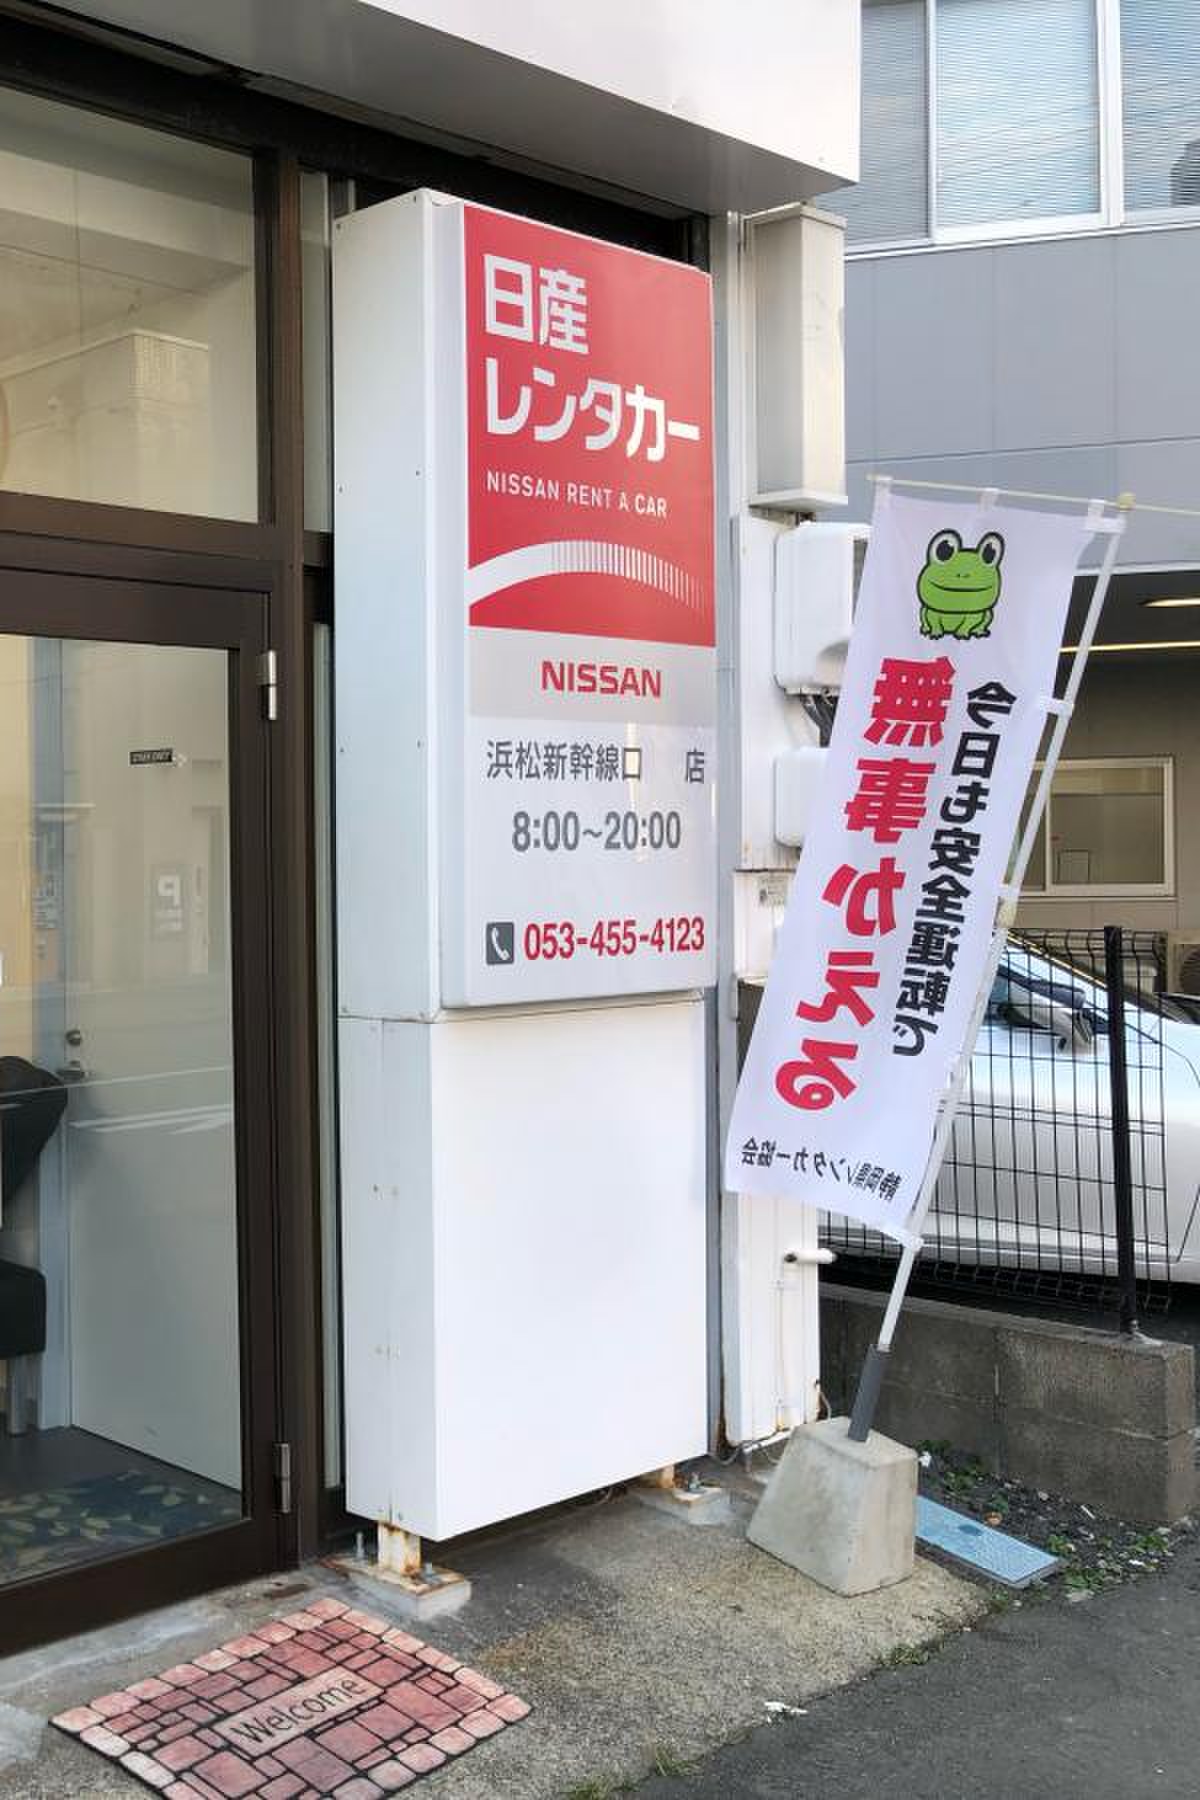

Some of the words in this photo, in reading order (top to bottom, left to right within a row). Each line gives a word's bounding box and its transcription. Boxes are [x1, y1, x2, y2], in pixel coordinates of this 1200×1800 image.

[484, 254, 589, 354] 日産
[486, 356, 700, 461] レンタカー
[487, 471, 559, 500] NISSAN
[567, 482, 611, 508] RENT
[619, 493, 630, 511] A
[634, 494, 667, 517] CAR
[541, 661, 662, 697] NISSAN
[486, 740, 643, 781] 浜松新幹線口
[685, 747, 706, 784] 店
[524, 917, 705, 960] 053-455-4123
[230, 1679, 367, 1744] Welcome
